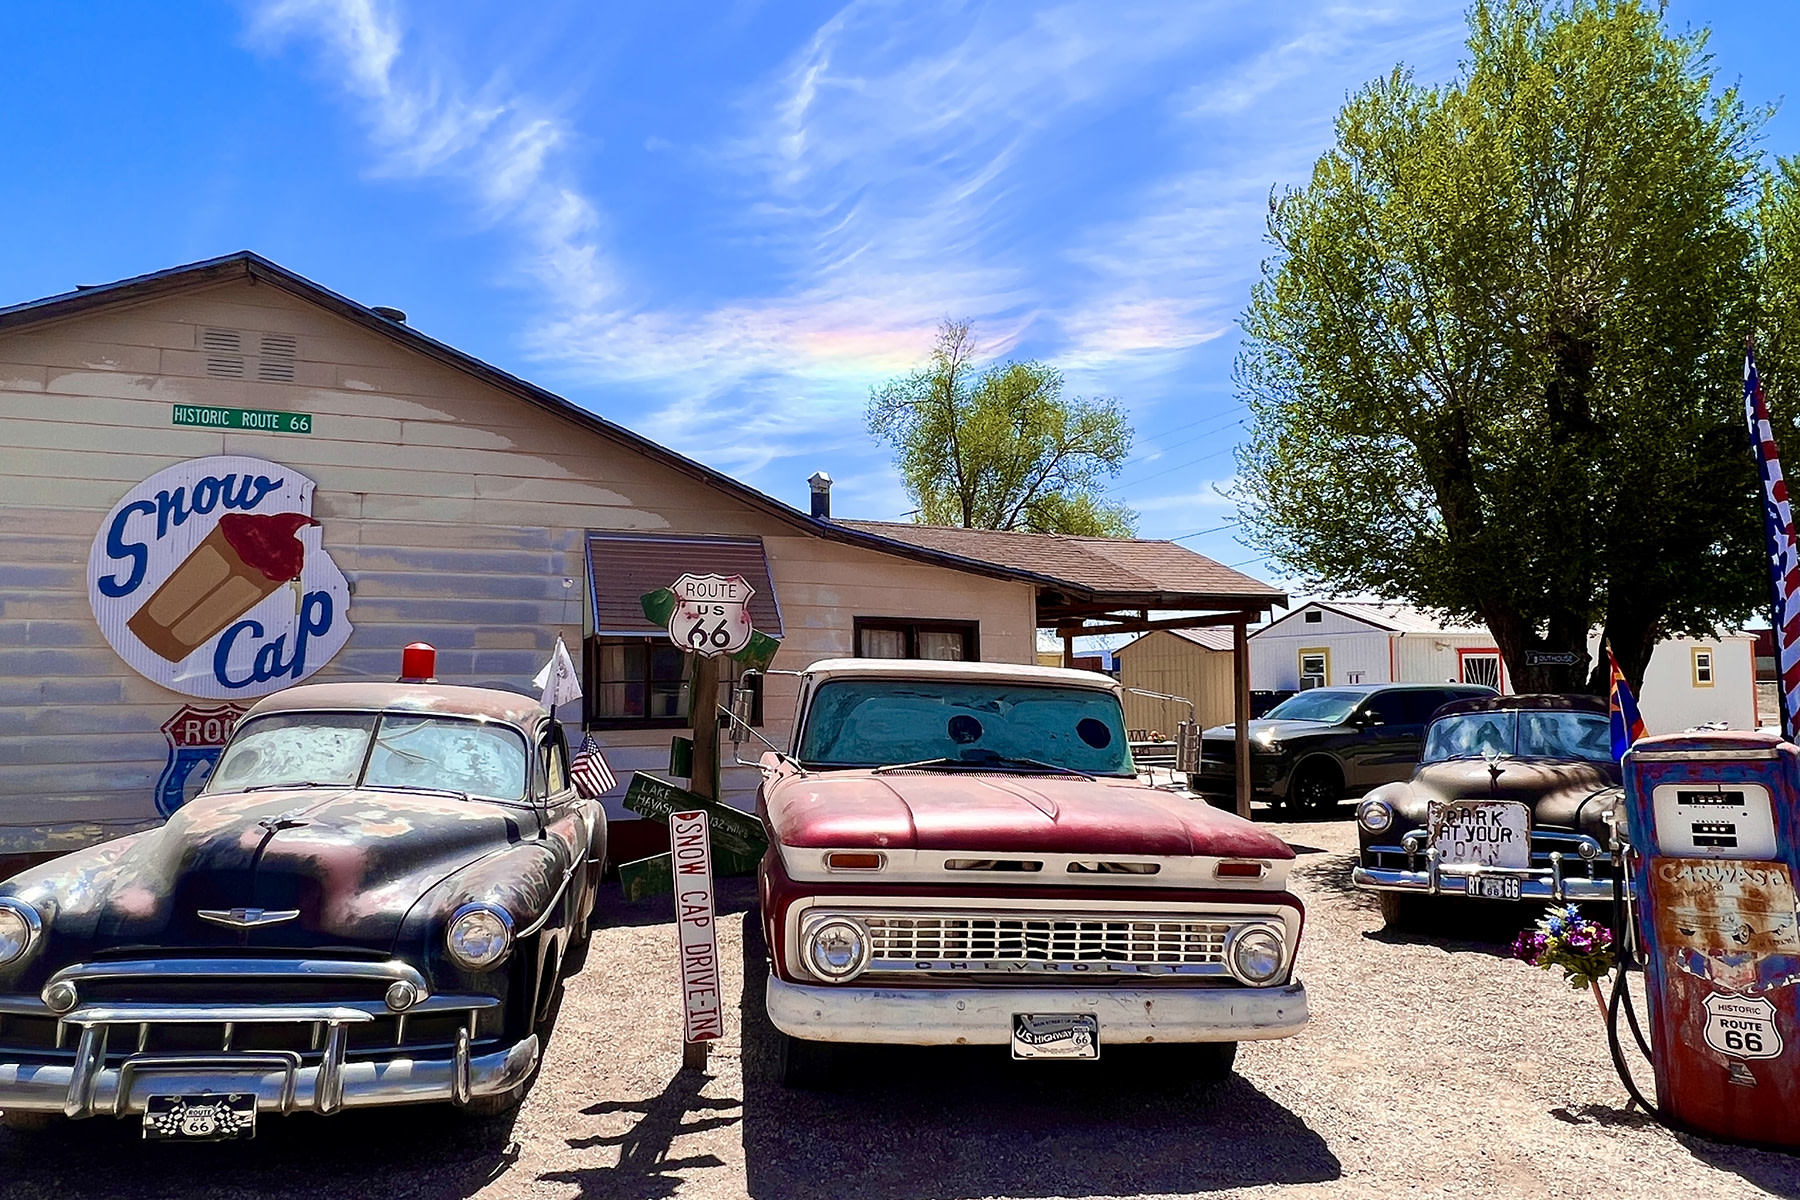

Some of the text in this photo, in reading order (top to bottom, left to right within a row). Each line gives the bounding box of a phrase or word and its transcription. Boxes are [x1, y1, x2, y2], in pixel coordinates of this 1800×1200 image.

[174, 406, 309, 431] HISTORIC ROUTE 66
[98, 473, 284, 598] Snow
[686, 582, 737, 598] ROUTE
[697, 605, 725, 615] US
[213, 590, 333, 689] Cap
[688, 618, 731, 648] 66
[641, 781, 671, 800] LAKE
[1447, 808, 1504, 827] PARK
[710, 817, 749, 839] 132 miles
[1440, 825, 1513, 843] AT YOUR
[1468, 876, 1519, 897] RT 66
[1486, 888, 1500, 896] 66
[676, 823, 718, 1032] SNOW CAP DRIVE-IN
[1718, 1004, 1762, 1015] HISTORIC
[1720, 1019, 1763, 1032] ROUTE
[1034, 1030, 1073, 1043] HIGHWAY
[1075, 1035, 1088, 1045] 66
[1725, 1030, 1763, 1052] 66
[189, 1122, 209, 1132] 66
